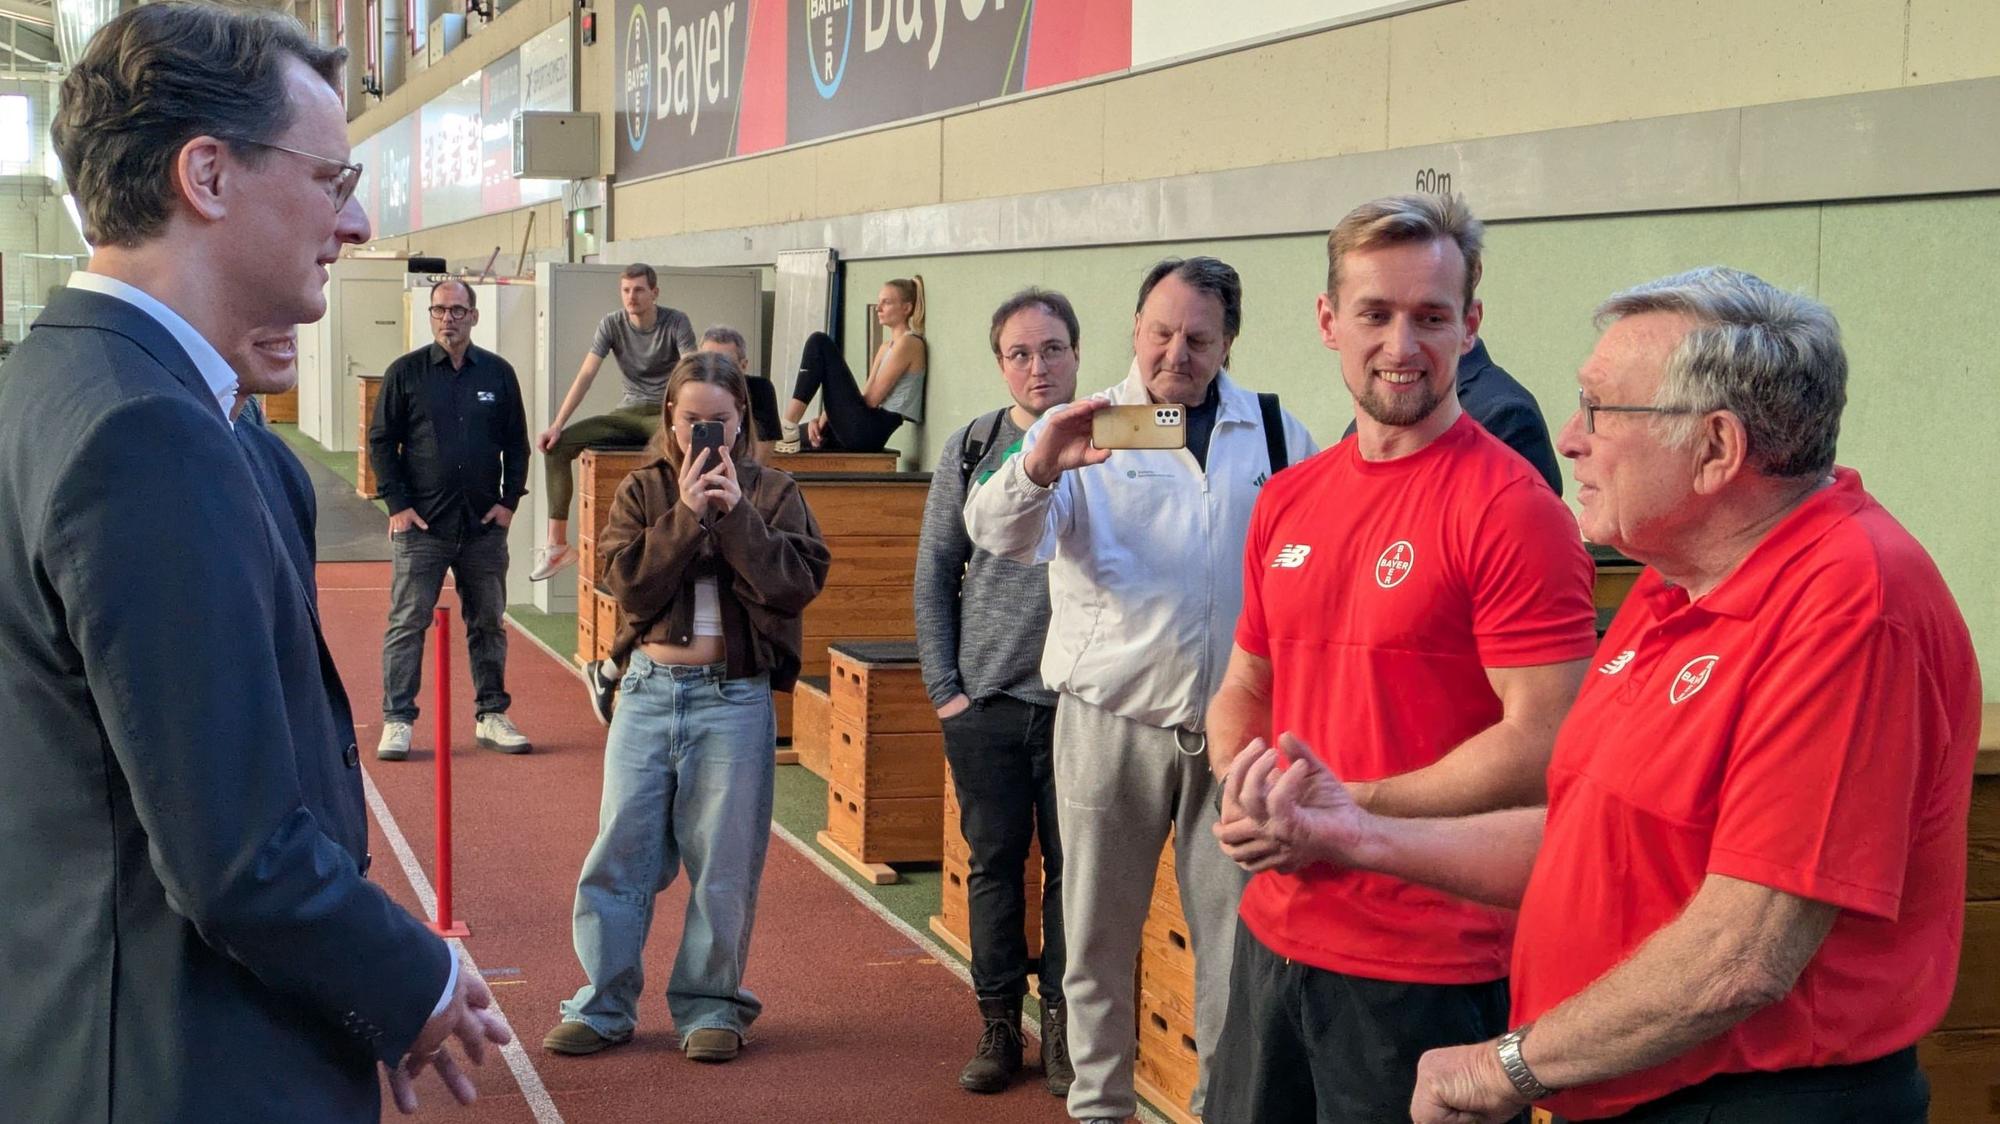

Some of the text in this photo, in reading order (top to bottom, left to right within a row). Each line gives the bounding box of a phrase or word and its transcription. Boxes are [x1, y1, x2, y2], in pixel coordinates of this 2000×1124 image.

[627, 63, 649, 92] BAYER
[656, 1, 736, 136] Bayer
[1415, 168, 1451, 193] 60m
[1380, 558, 1409, 570] BAYER
